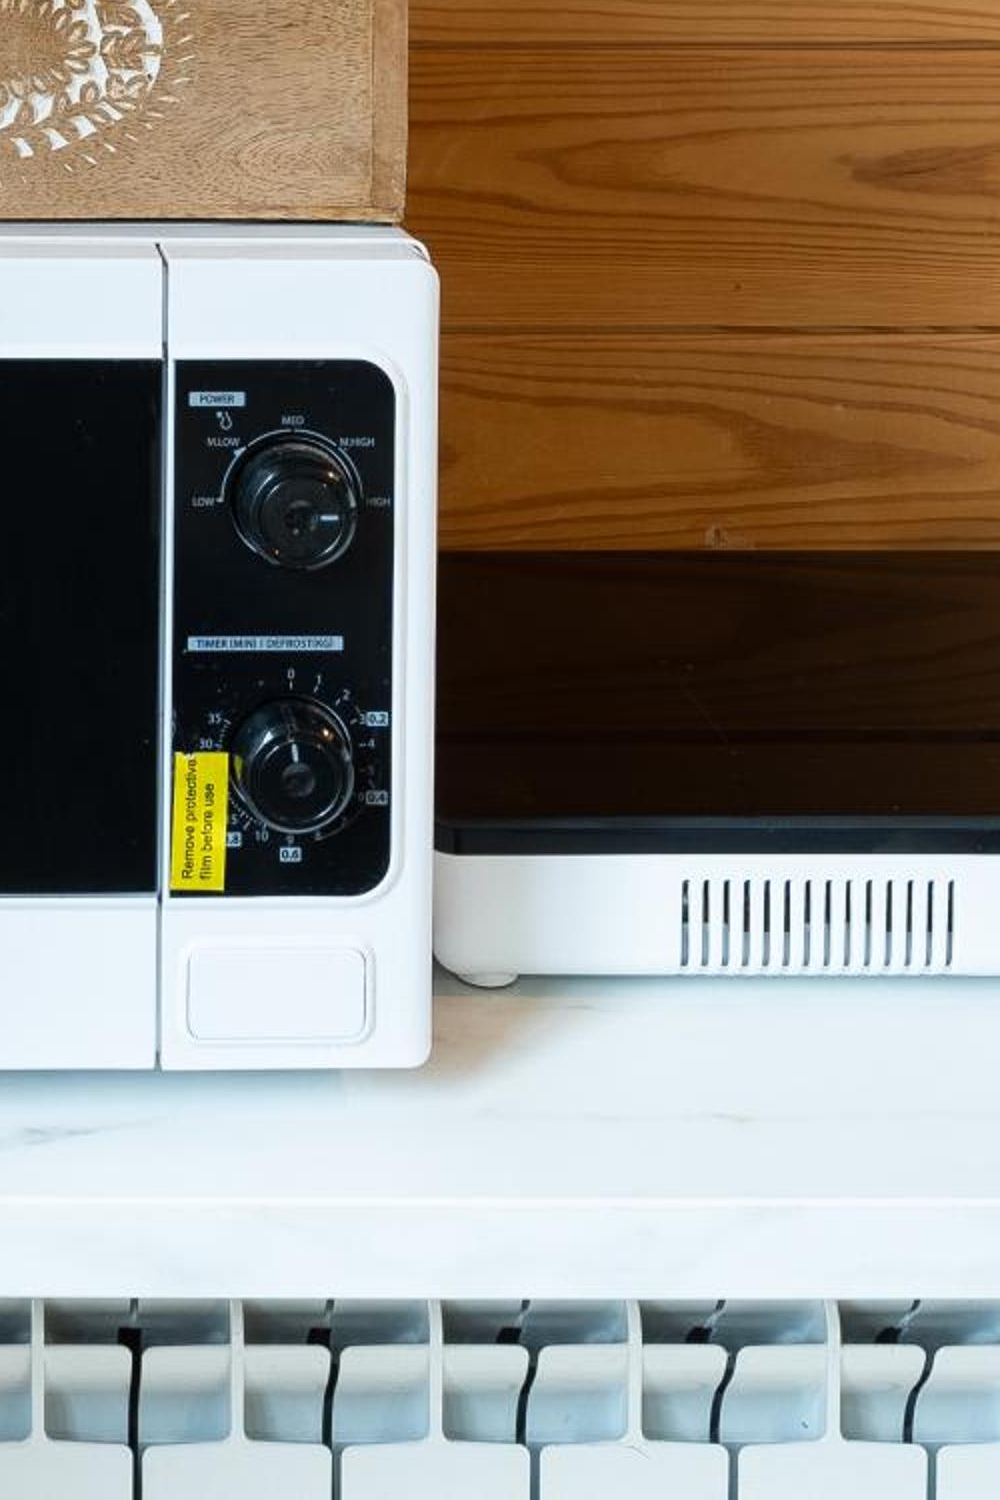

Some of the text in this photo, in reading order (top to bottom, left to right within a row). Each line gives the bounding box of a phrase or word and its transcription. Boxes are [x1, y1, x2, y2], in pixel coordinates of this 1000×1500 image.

[199, 394, 235, 404] POWER
[281, 415, 305, 425] MED
[192, 497, 215, 507] LOW
[366, 498, 391, 506] HIGH
[196, 638, 228, 649] TIMER
[287, 667, 295, 679] 0
[343, 688, 351, 700] 2
[369, 713, 386, 725] 0.2
[199, 737, 213, 749] 30
[182, 758, 199, 880] Remove protective
[199, 782, 215, 880] film before use
[255, 830, 269, 842] 10
[281, 849, 299, 859] 0.6
